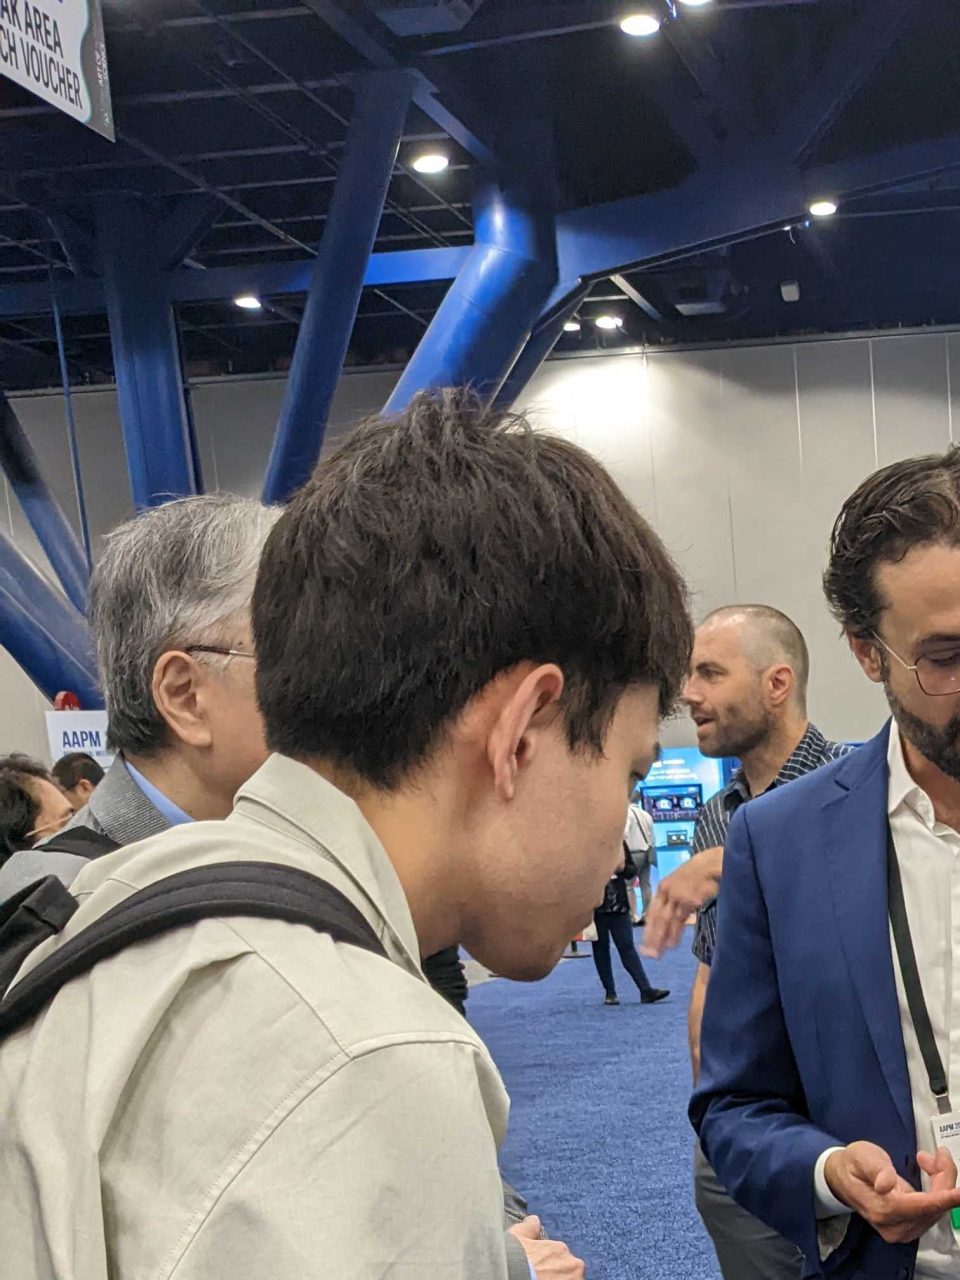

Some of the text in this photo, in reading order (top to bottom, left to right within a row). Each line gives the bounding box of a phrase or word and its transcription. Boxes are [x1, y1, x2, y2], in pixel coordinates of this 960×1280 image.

[25, 1, 64, 58] AREA
[20, 37, 83, 110] VOUCHER
[62, 731, 101, 748] AAPM
[939, 1123, 954, 1133] AAPM
